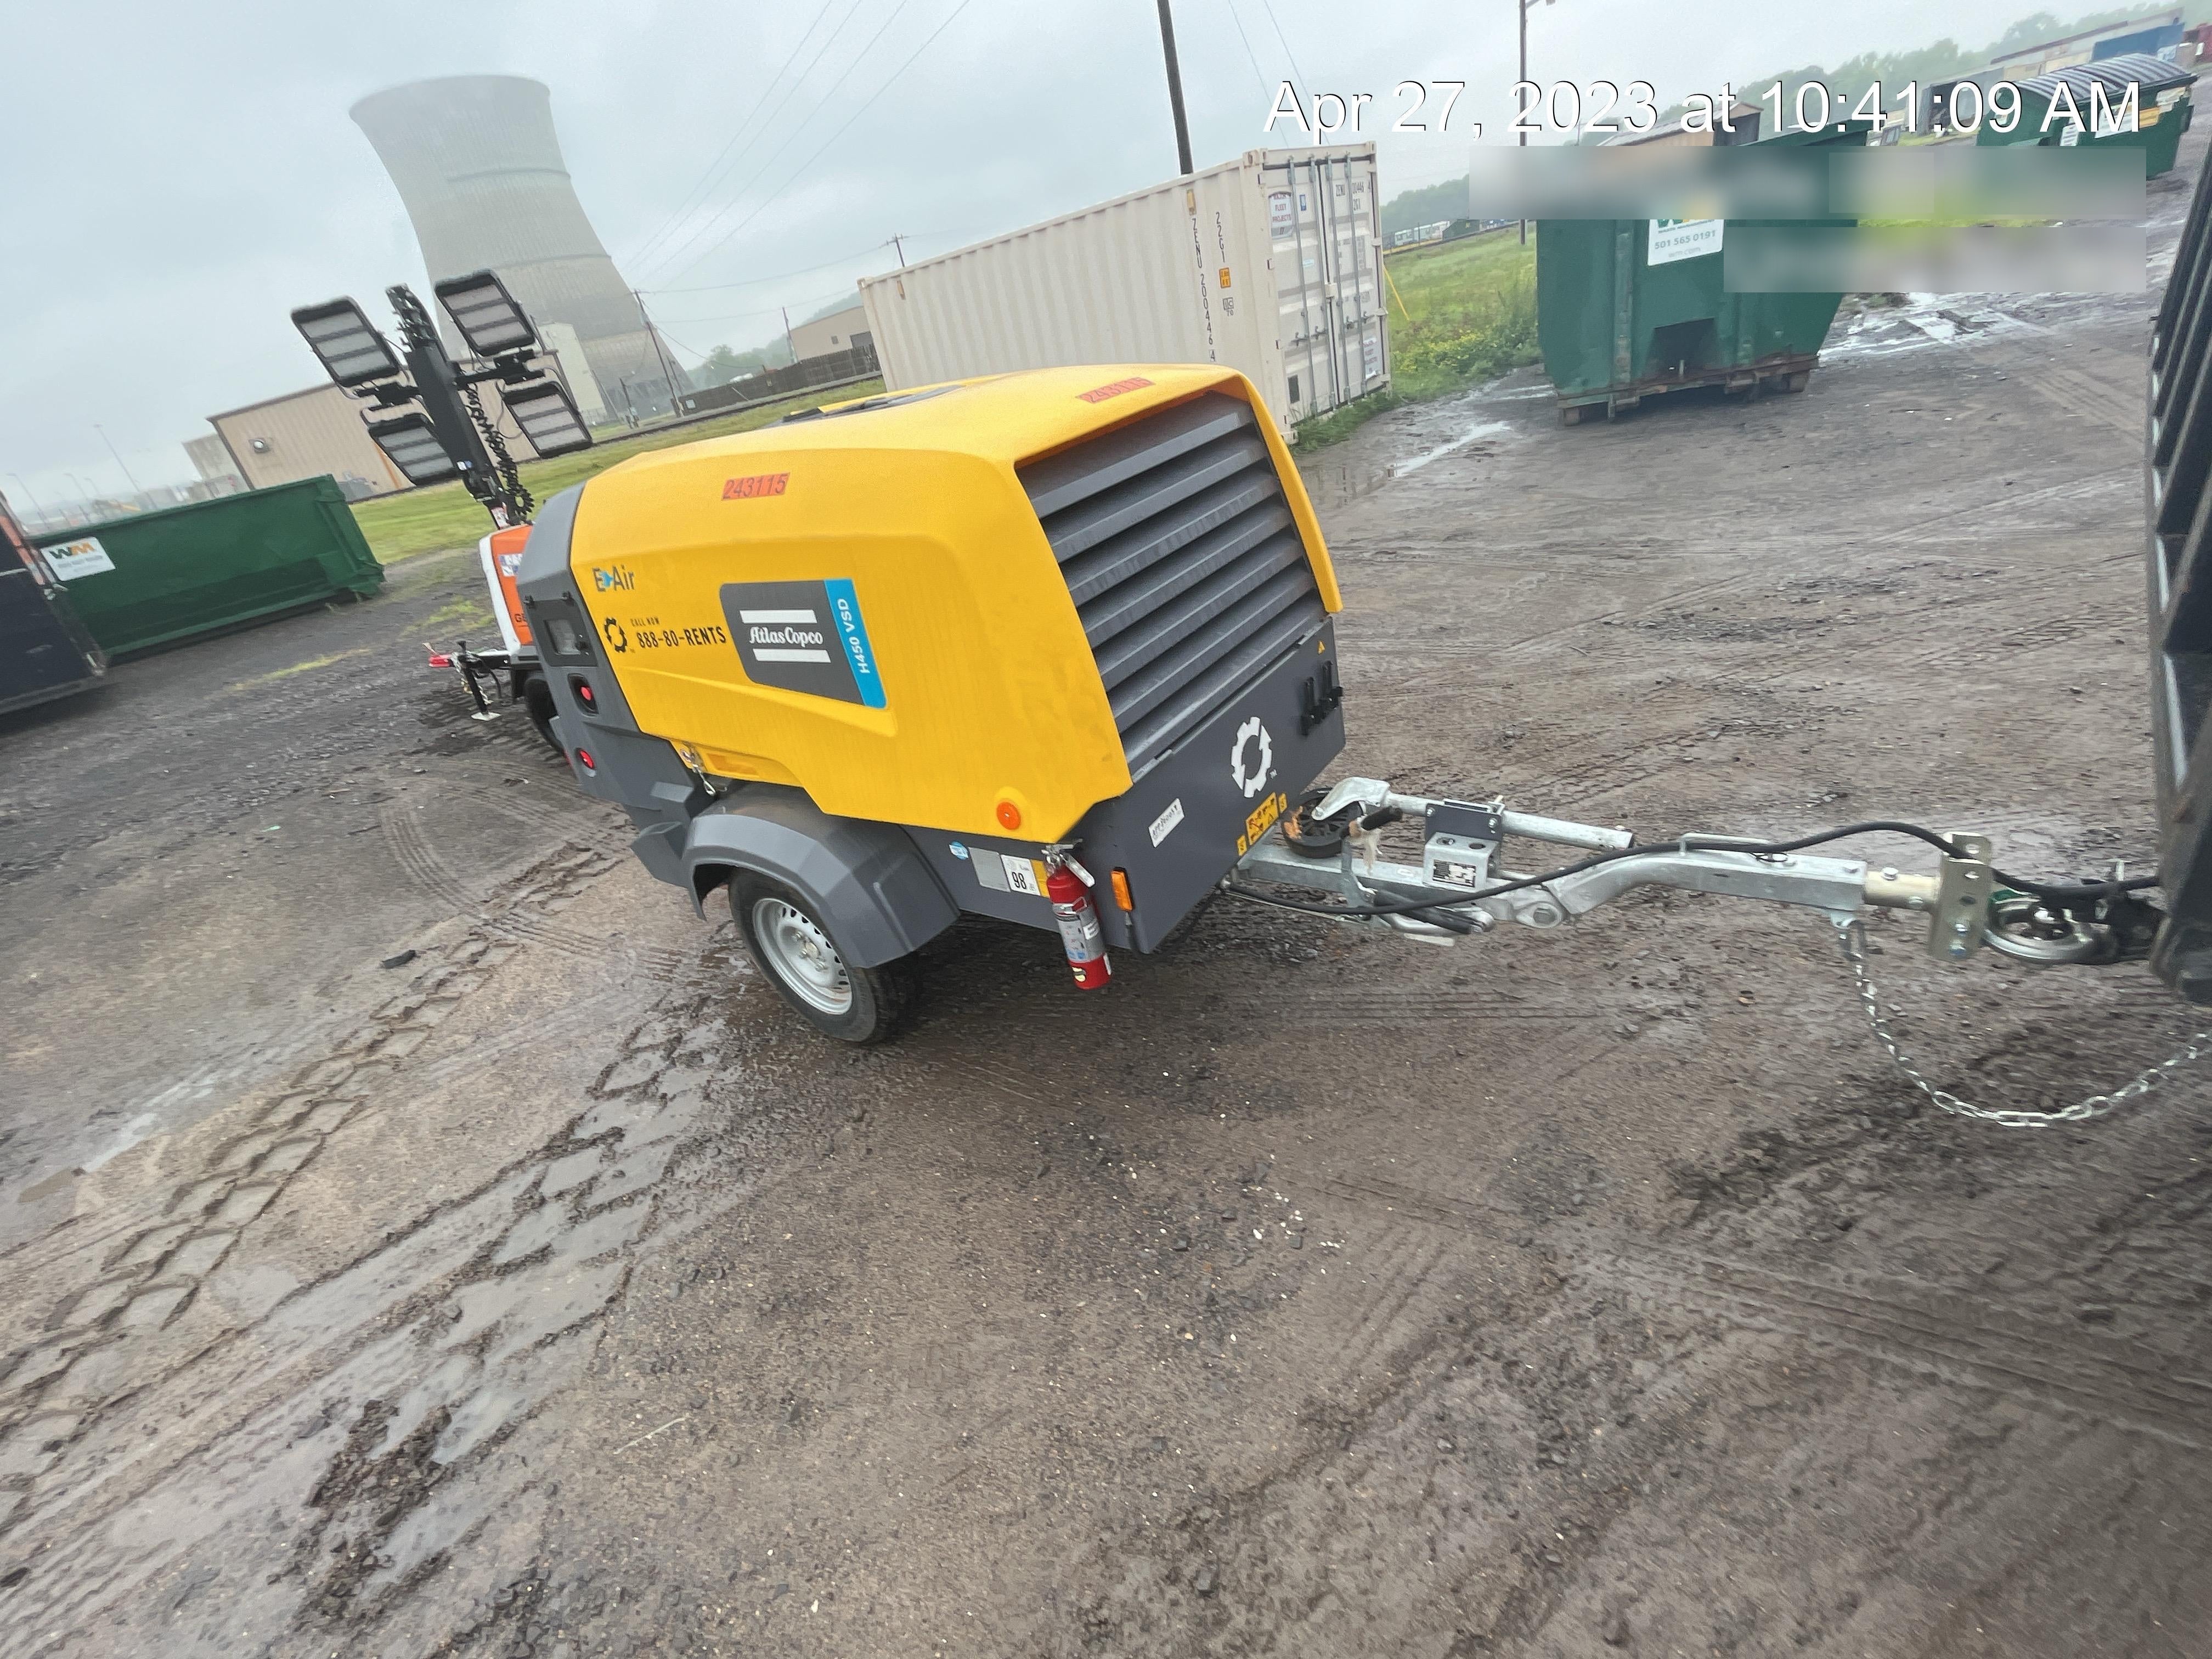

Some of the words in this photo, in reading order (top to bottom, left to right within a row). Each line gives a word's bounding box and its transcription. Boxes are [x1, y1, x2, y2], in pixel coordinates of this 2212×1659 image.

[1216, 212, 1226, 263] 22G1
[1655, 240, 1671, 249] 501
[1673, 235, 1691, 245] 565
[1692, 230, 1716, 241] 0191
[1200, 274, 1213, 345] 200446
[723, 473, 789, 499] 243115
[49, 543, 94, 558] WM
[630, 618, 646, 628] CALL
[646, 616, 660, 625] NOW
[837, 599, 855, 633] VSD
[636, 626, 726, 648] 888-80-RENTS
[849, 636, 870, 674] H450
[1012, 872, 1026, 889] 98
